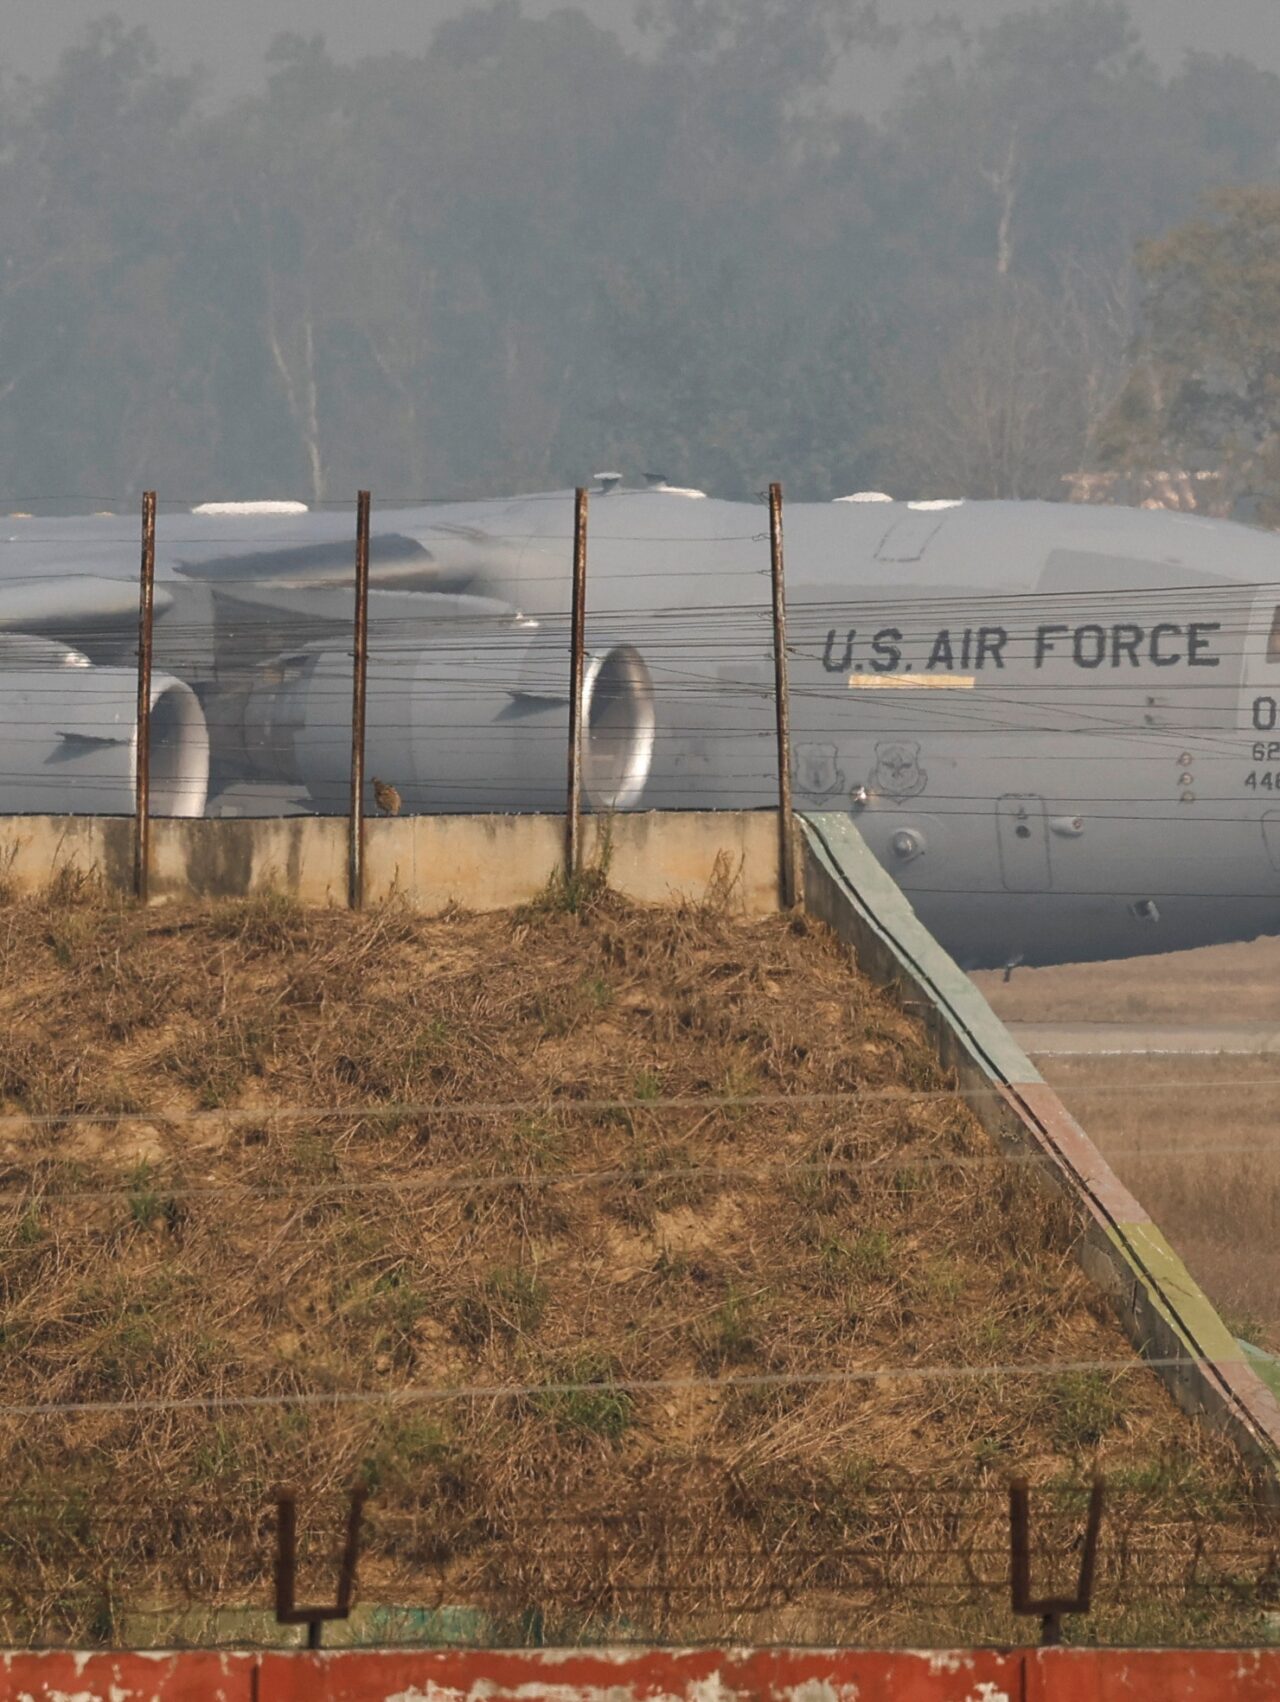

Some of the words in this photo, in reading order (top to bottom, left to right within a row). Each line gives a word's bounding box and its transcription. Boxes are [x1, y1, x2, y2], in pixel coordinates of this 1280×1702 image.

[821, 627, 913, 673] U.S.
[926, 625, 1008, 670] AIR
[1034, 622, 1221, 669] FORCE
